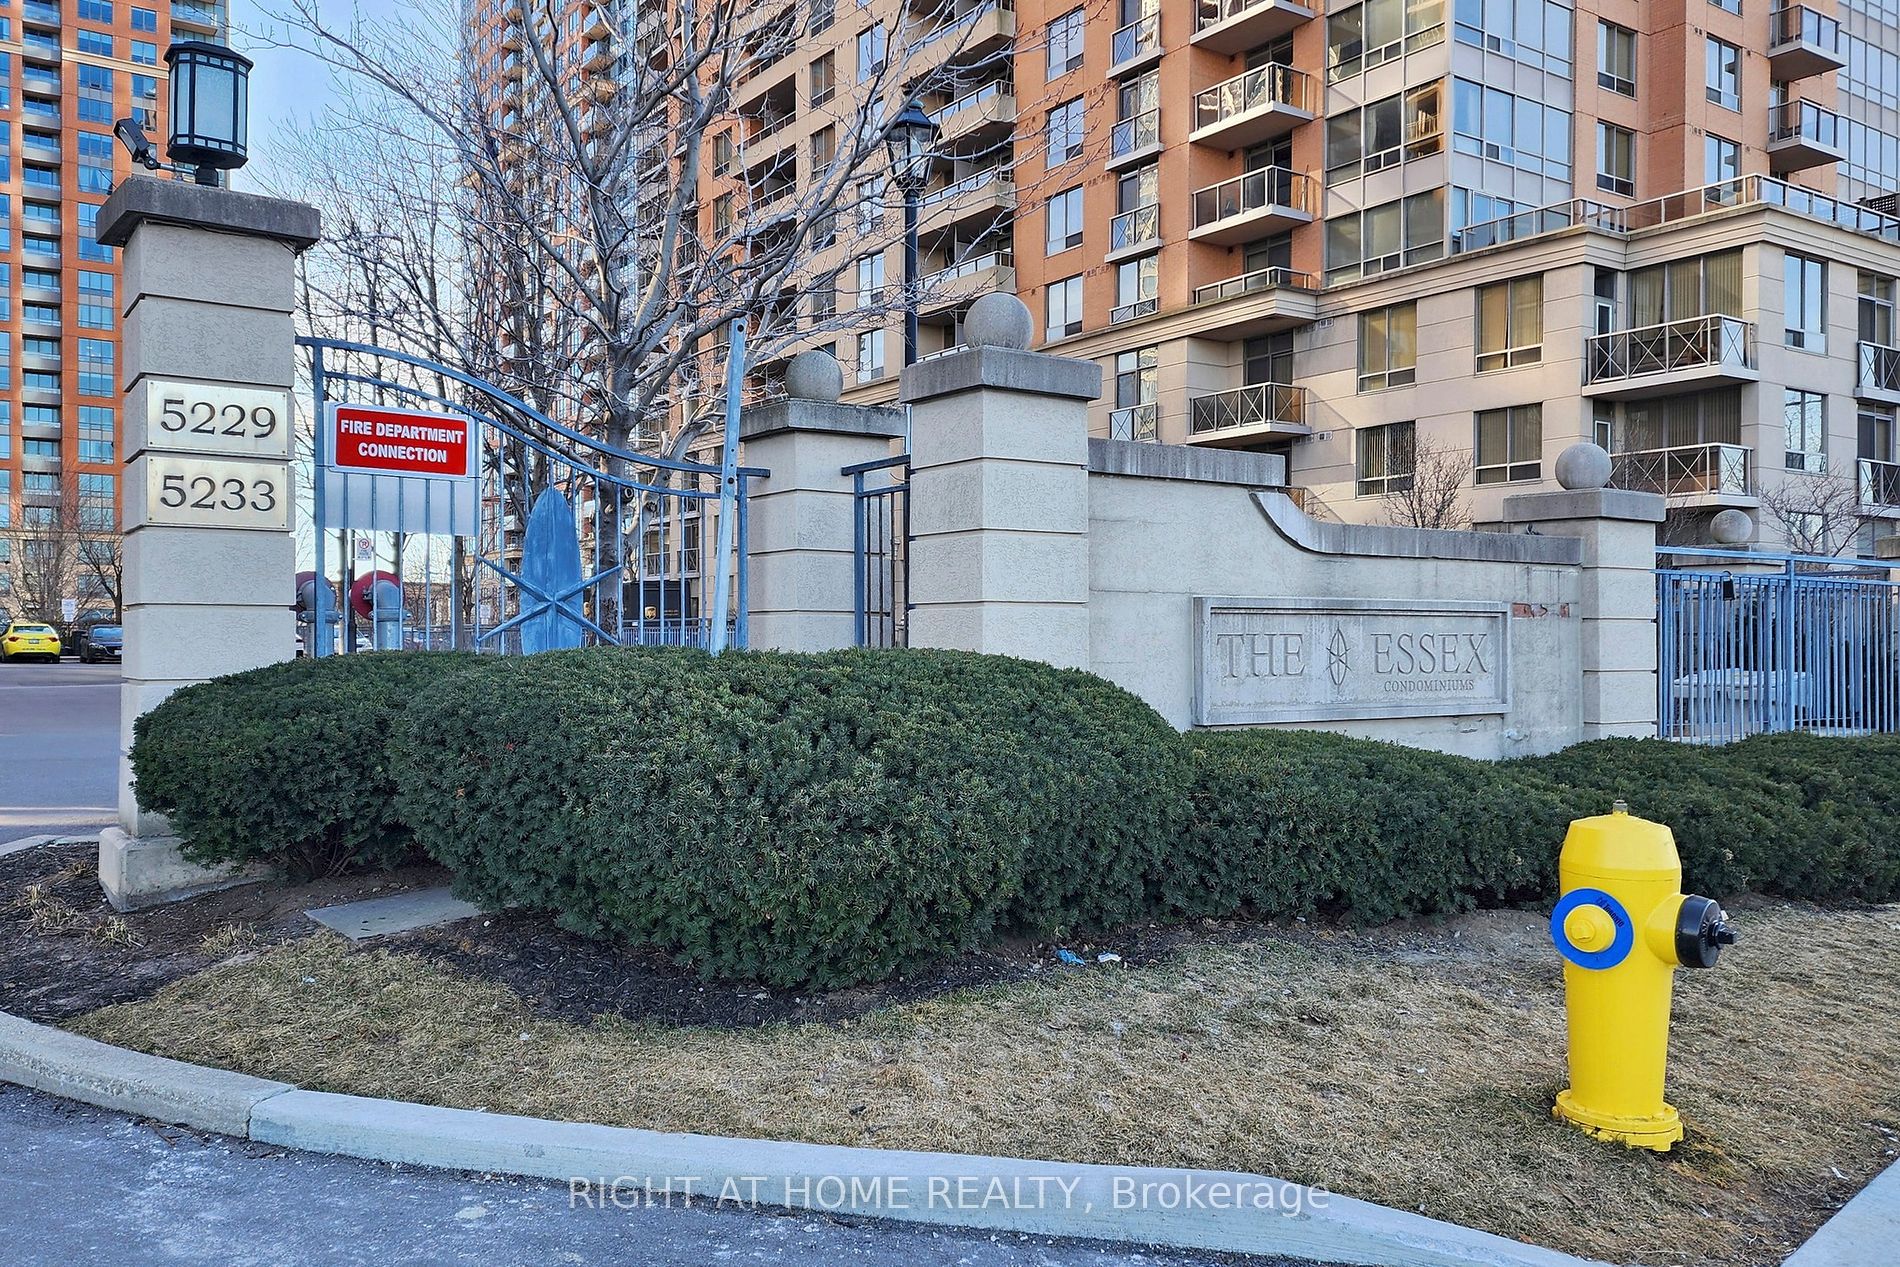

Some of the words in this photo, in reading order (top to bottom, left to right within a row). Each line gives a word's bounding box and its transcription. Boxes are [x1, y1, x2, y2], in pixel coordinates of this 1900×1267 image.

[160, 398, 276, 438] 5229
[340, 419, 373, 436] FIRE
[375, 422, 464, 444] DEPARTMENT
[358, 442, 448, 463] CONNECTION
[160, 474, 276, 511] 5233
[1216, 632, 1306, 678] THE
[1370, 632, 1488, 675] ESSEX
[1384, 679, 1475, 692] CONDOMINIUMS
